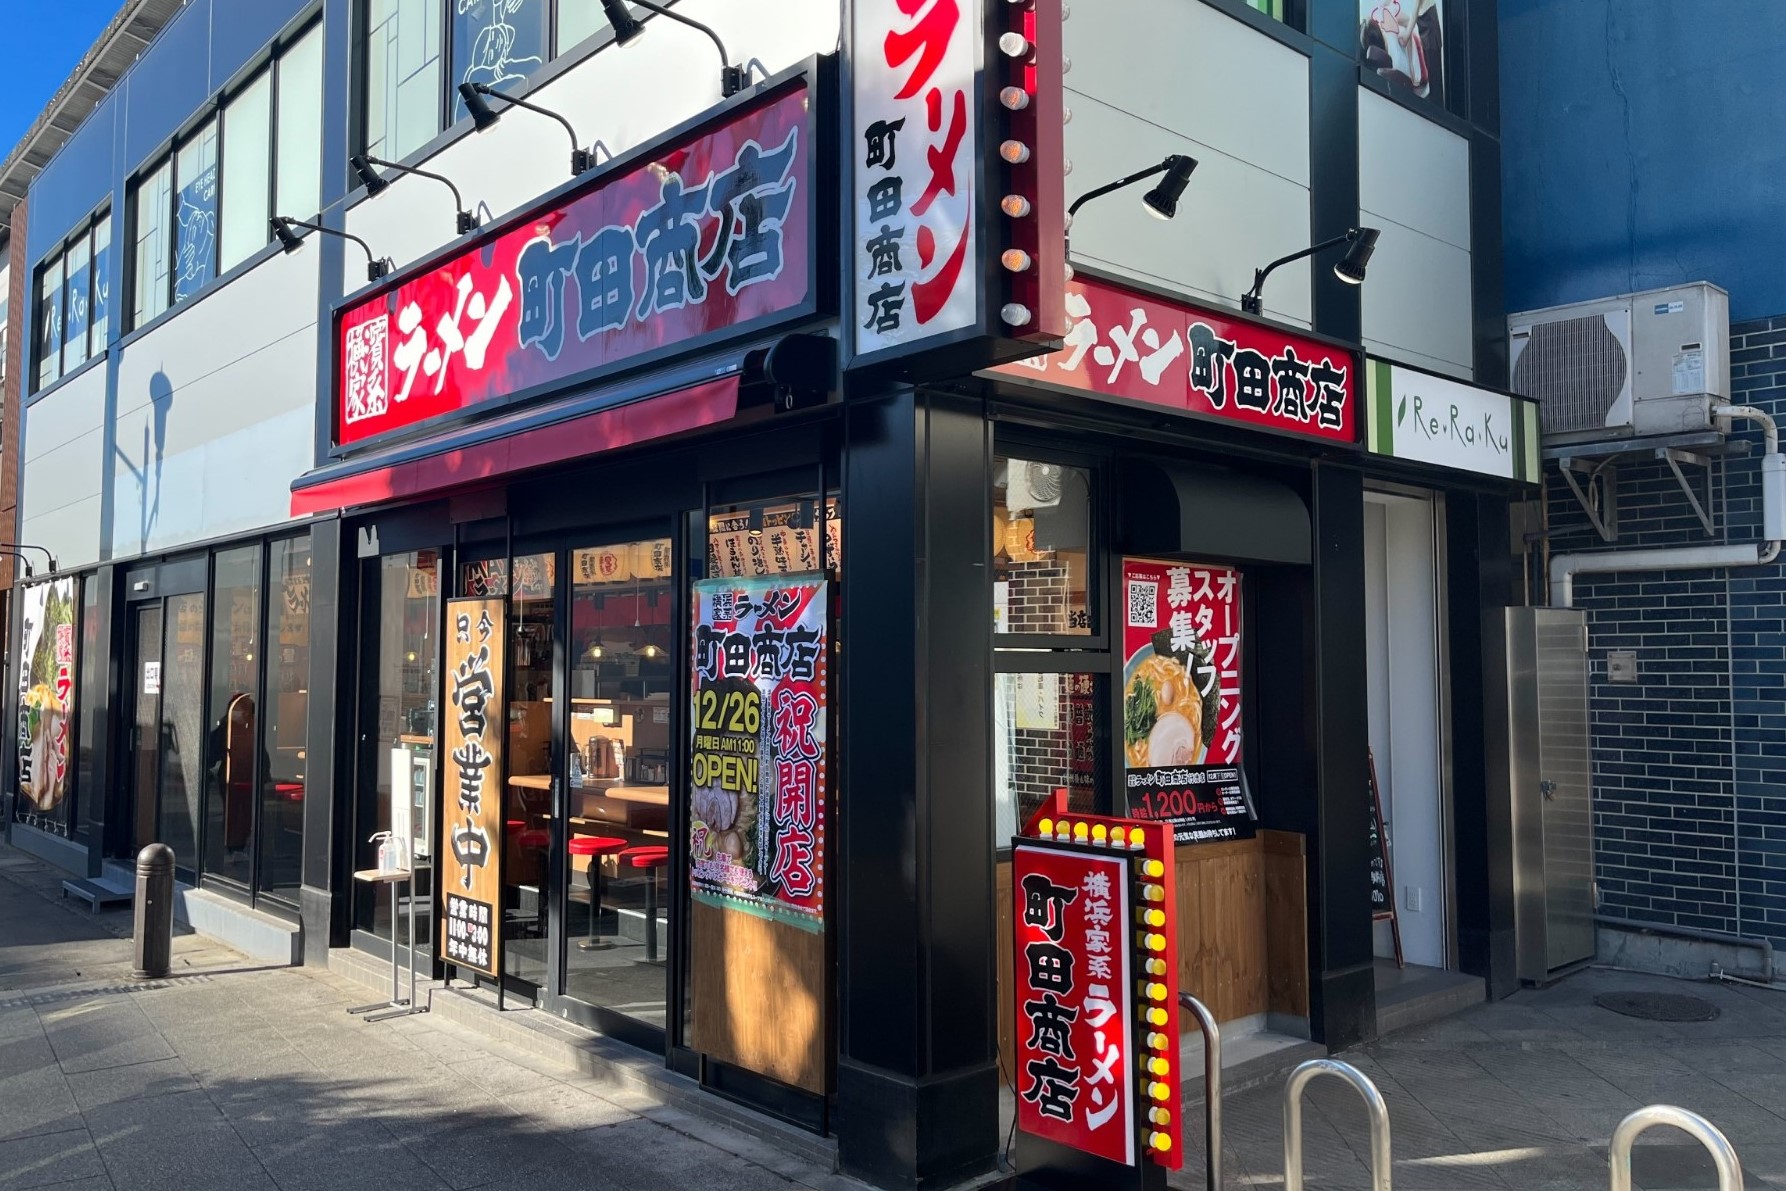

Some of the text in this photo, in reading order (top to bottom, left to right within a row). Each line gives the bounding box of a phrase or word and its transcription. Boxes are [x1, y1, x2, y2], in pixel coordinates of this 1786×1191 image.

[864, 115, 906, 334] 町田商店
[884, 0, 970, 325] ラーメン
[394, 272, 513, 402] ラーメン
[517, 125, 799, 362] 町田商店
[1058, 291, 1347, 430] ラーメン 町田商店
[694, 622, 822, 682] 町田商店
[733, 589, 801, 621] ラーメン
[1166, 566, 1198, 697] 募集!
[1192, 569, 1218, 699] スタッフ
[1217, 569, 1242, 766] オープニング
[55, 666, 73, 783] ラーメン
[451, 645, 495, 891] 営業中
[692, 752, 758, 794] OPEN!
[693, 689, 760, 734] 12/26
[696, 735, 720, 752] 月曜日
[770, 688, 821, 899] 祝開店
[448, 937, 488, 967] 年中無休
[1021, 872, 1079, 1122] 町田商店
